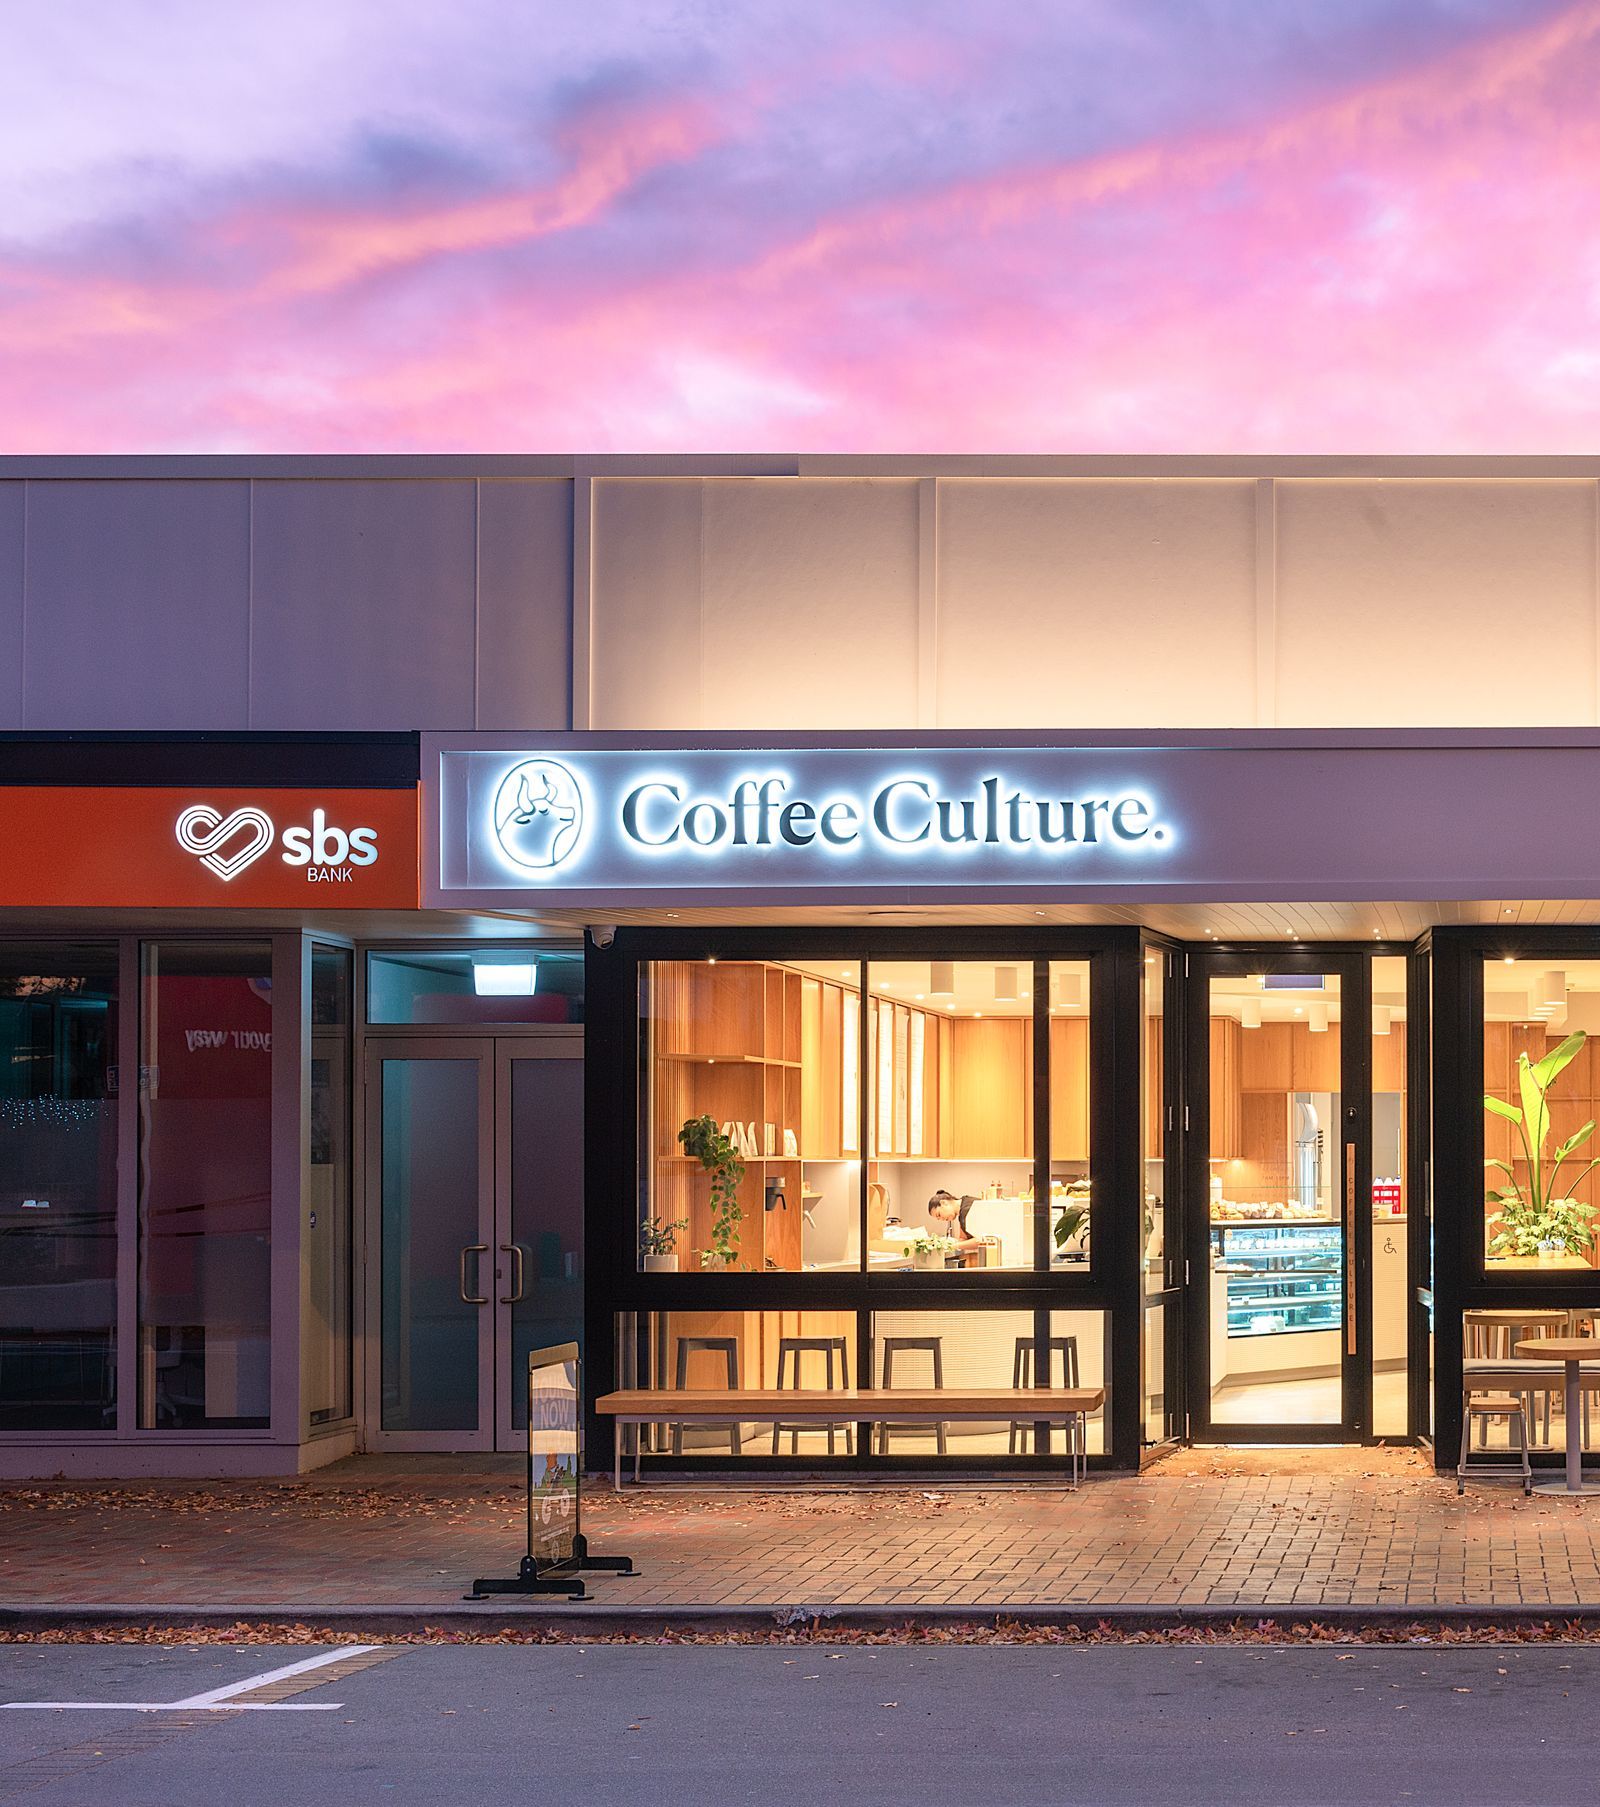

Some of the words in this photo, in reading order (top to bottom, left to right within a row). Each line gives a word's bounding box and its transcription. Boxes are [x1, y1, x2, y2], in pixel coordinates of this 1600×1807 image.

[281, 808, 379, 867] sbs
[622, 778, 860, 846] Coffee
[873, 777, 1166, 846] Culture.
[307, 867, 353, 883] BANK
